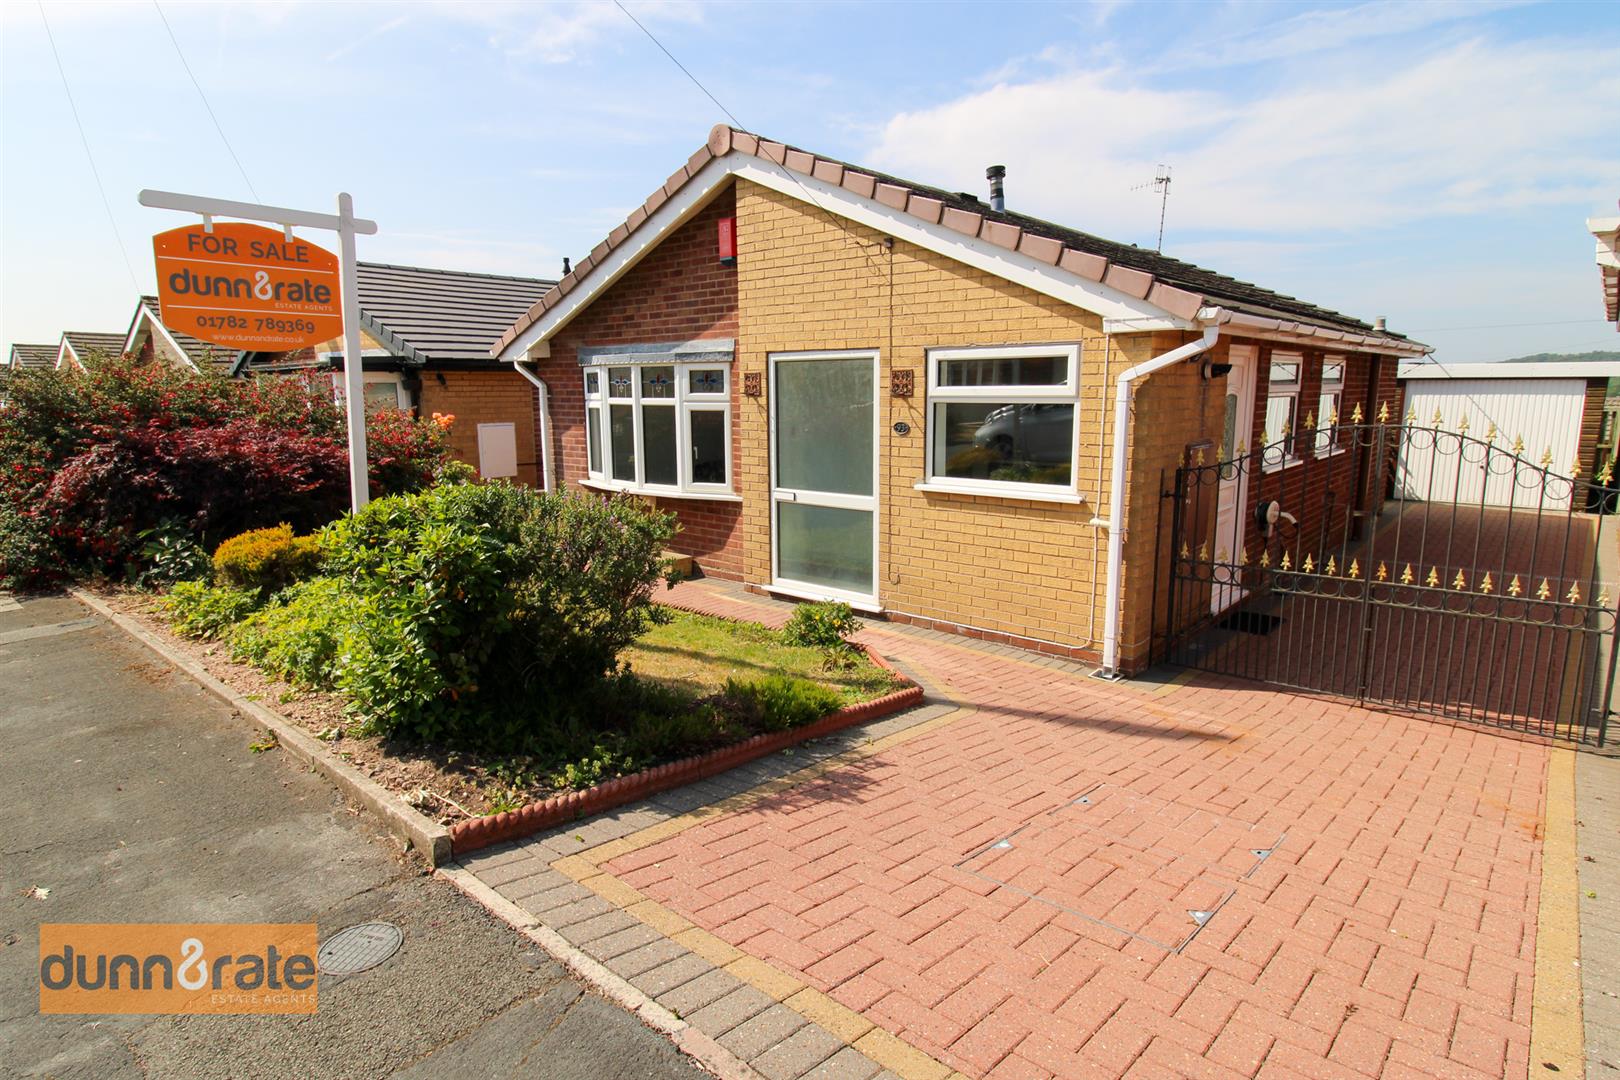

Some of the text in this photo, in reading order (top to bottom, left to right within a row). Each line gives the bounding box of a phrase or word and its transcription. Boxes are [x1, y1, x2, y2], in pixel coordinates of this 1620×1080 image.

[188, 233, 309, 263] FOR SALE
[275, 302, 333, 312] ESTATE AGENTS
[196, 315, 315, 334] 01782 789369
